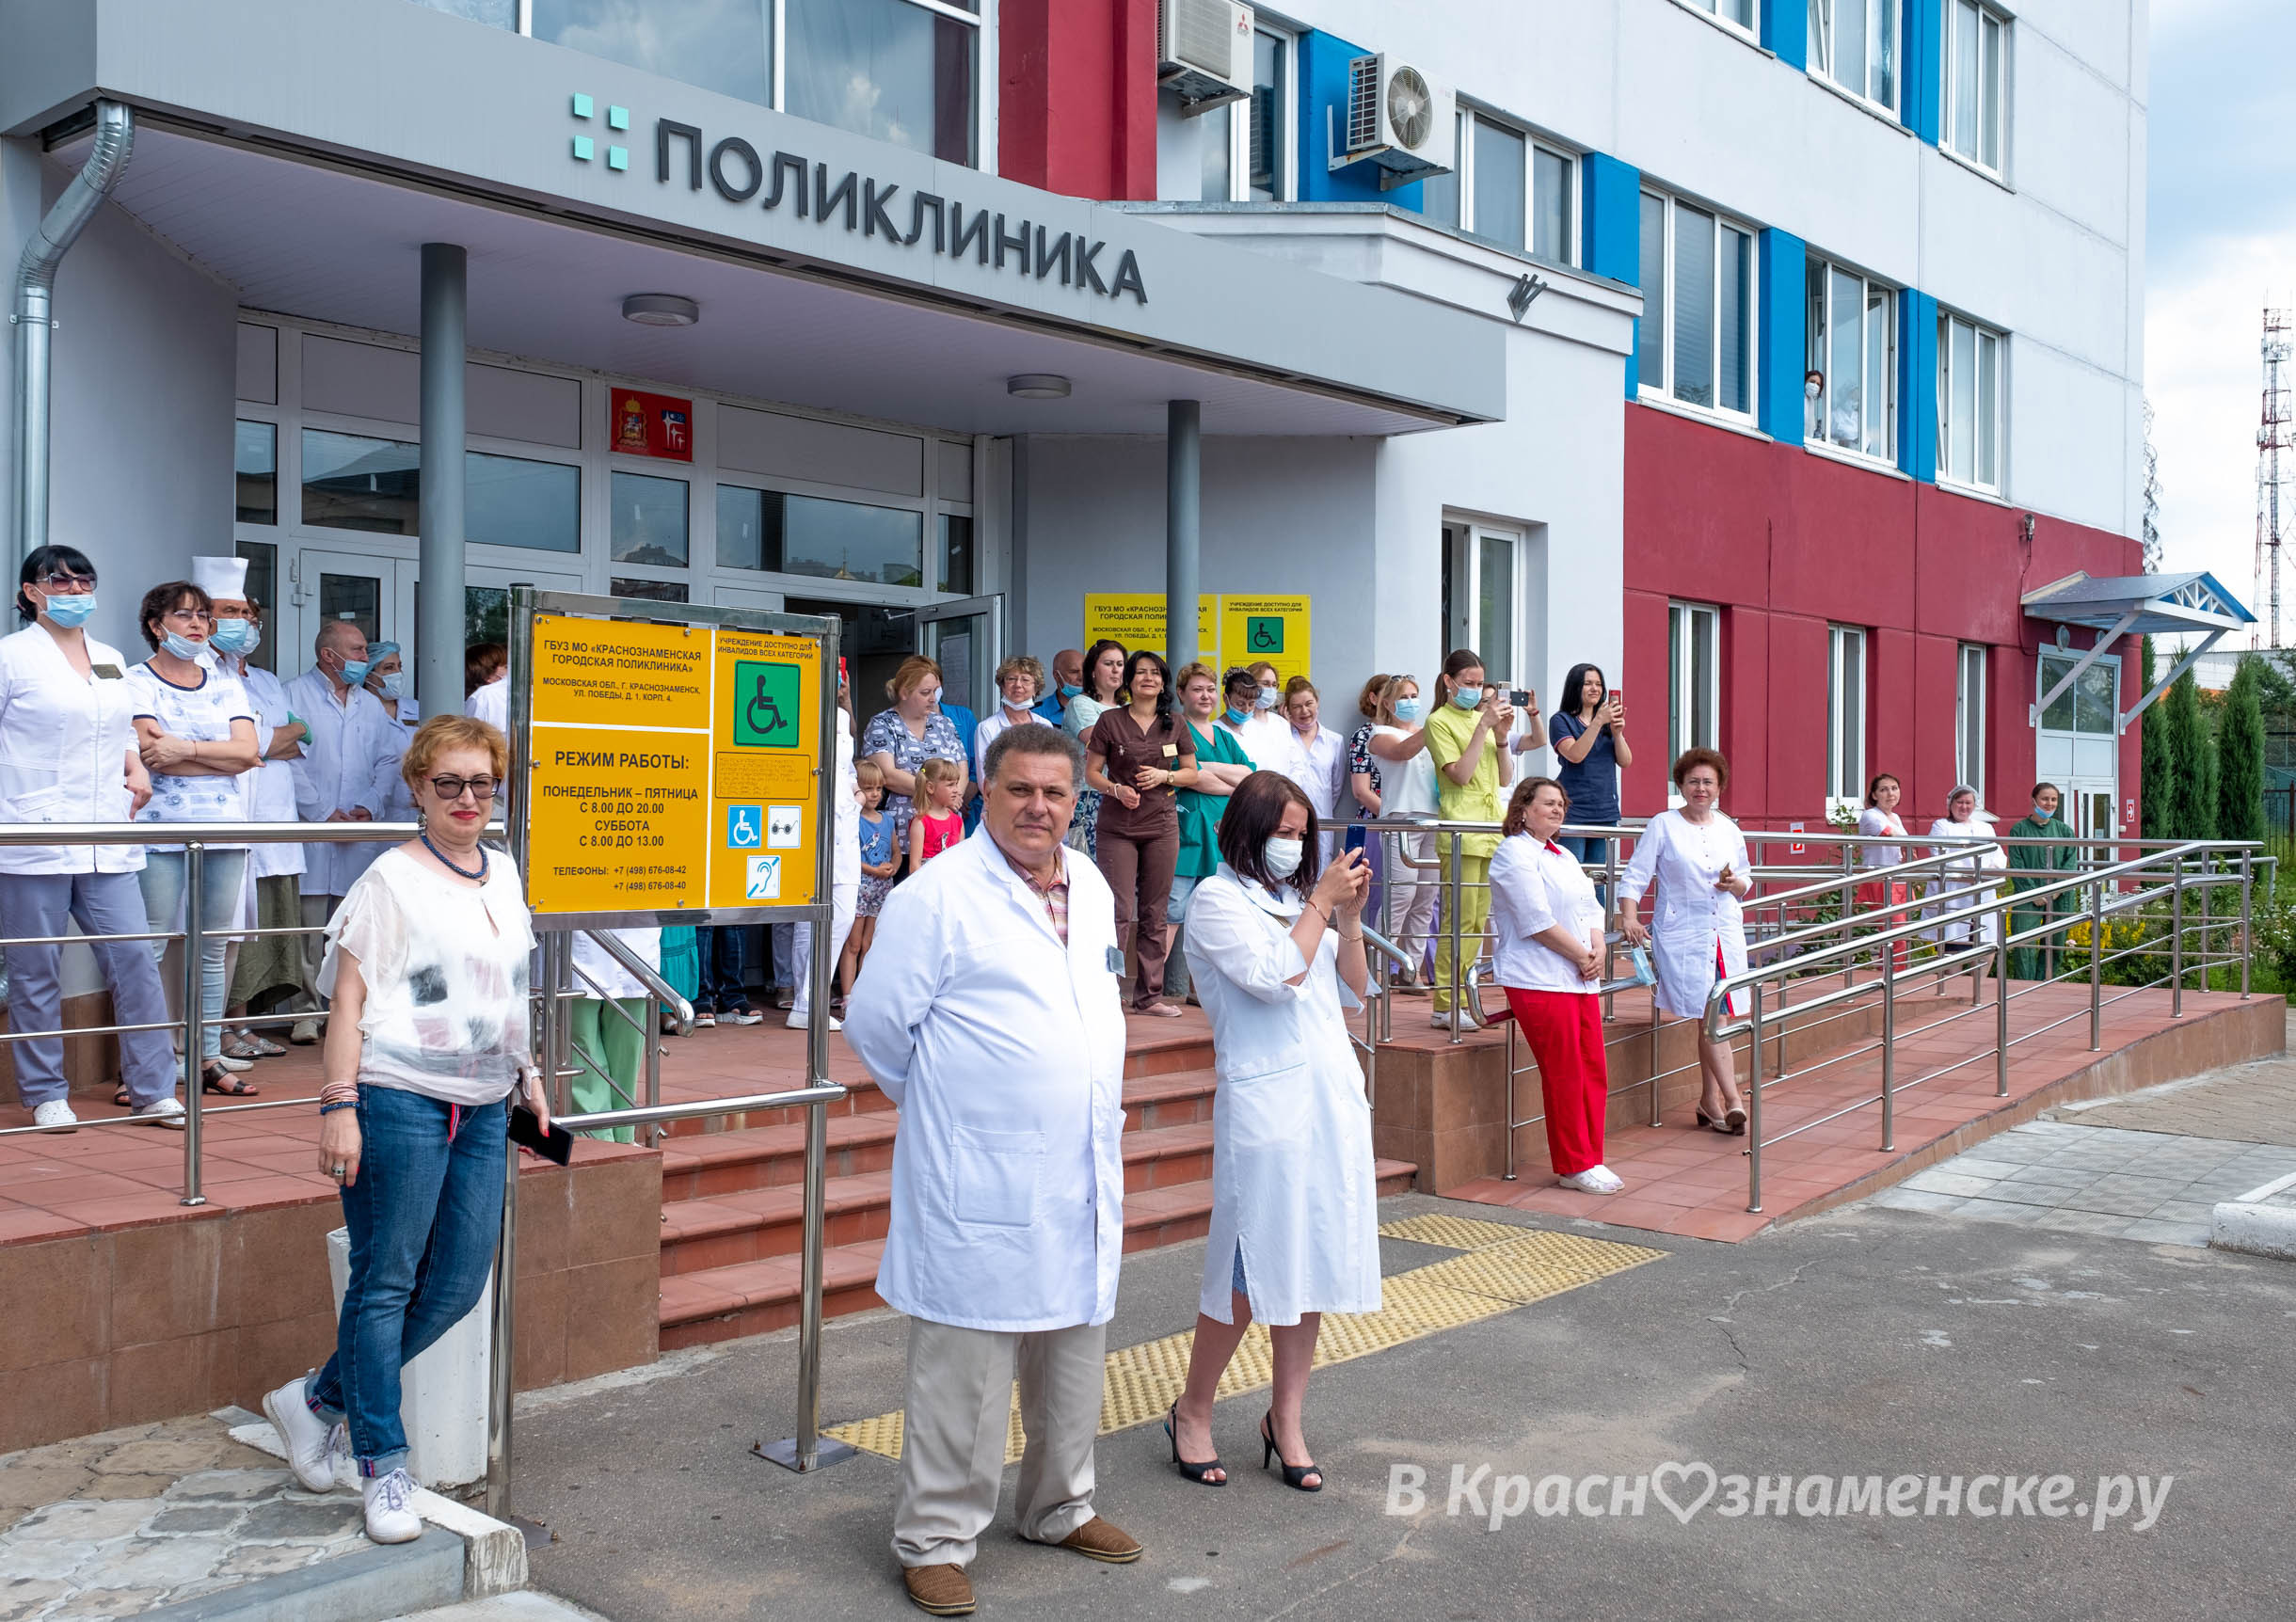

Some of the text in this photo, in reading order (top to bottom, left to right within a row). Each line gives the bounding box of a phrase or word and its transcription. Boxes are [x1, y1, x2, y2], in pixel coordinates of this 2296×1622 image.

[659, 118, 1148, 304] ПОЛИКЛИНИКА
[719, 638, 762, 647] УЧРЕЖДЕНИЕ
[764, 641, 798, 650] ДОСТУПНО
[544, 640, 701, 661] ГБУЗ МО «КРАСНОЗНАМЕНСКАЯ
[718, 647, 757, 655] ИНВАЛИДОВ
[552, 654, 693, 673] ГОРОДСКАЯ ПОЛИКЛИНИКА»
[543, 677, 597, 688] МОСКОВСКАЯ
[588, 690, 624, 700] ПОБЕДЫ,
[555, 751, 689, 769] РЕЖИМ РАБОТЫ:
[543, 786, 633, 799] ПОНЕДЕЛЬНИК
[645, 788, 698, 800] ПЯТНИЦА
[580, 802, 664, 815] С 8.00 ДО 20.00
[595, 820, 650, 831] СУББОТА
[579, 836, 664, 848] С 8.00 ДО 13.00
[554, 866, 686, 876] ТЕЛЕФОНЫ: +7 (498) 676-08-42
[614, 881, 686, 892] +7 (498) 676-08-40
